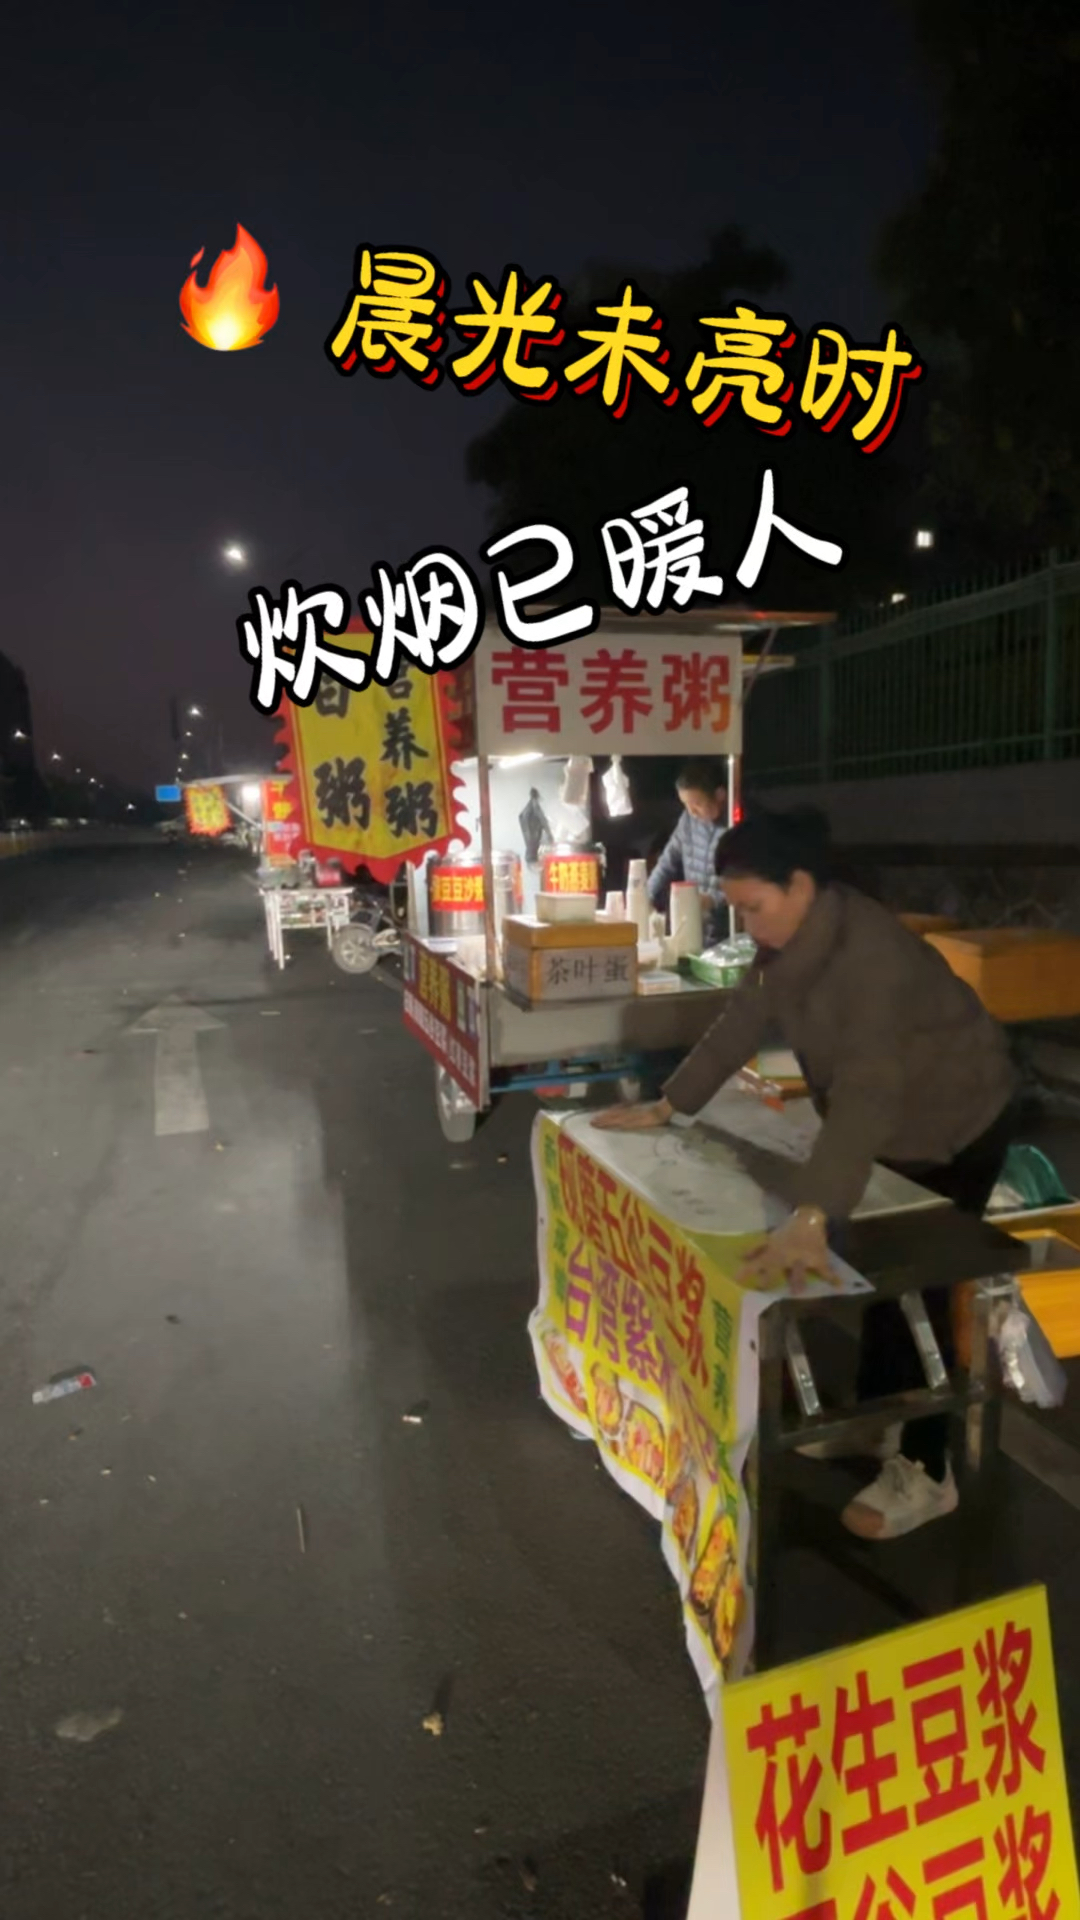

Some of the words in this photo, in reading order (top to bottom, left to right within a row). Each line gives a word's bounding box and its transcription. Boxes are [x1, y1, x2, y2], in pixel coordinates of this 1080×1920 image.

[492, 646, 732, 734] 营养粥
[548, 953, 629, 986] 茶叶蛋
[745, 1620, 1046, 1894] 花生豆浆
